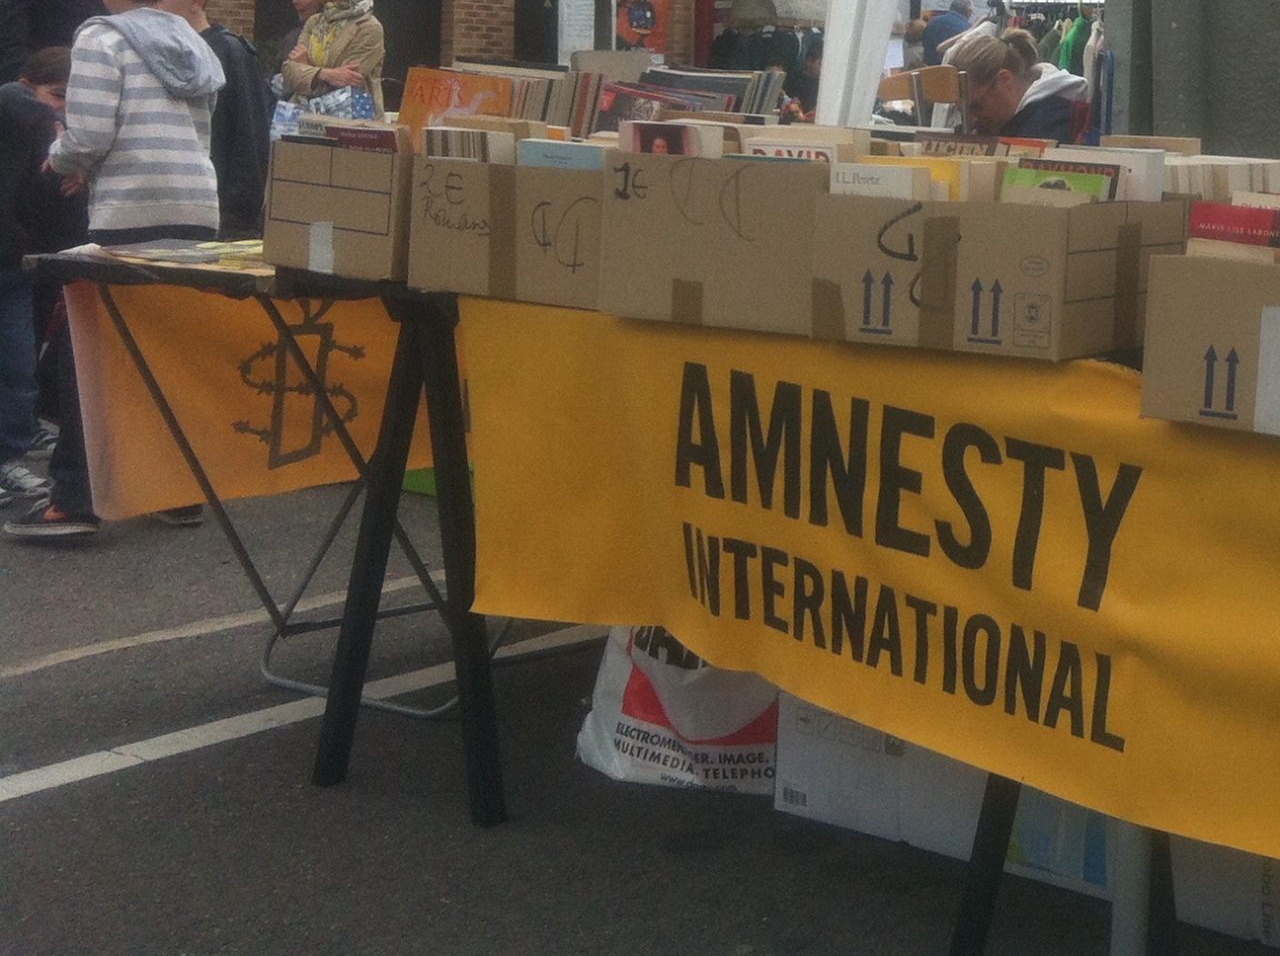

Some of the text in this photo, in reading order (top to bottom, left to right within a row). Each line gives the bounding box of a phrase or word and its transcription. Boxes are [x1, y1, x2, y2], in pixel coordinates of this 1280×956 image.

[674, 361, 1144, 612] AMNESTY
[615, 721, 714, 765] ELECTROMENER.
[682, 521, 1126, 753] INTERNATIONAL
